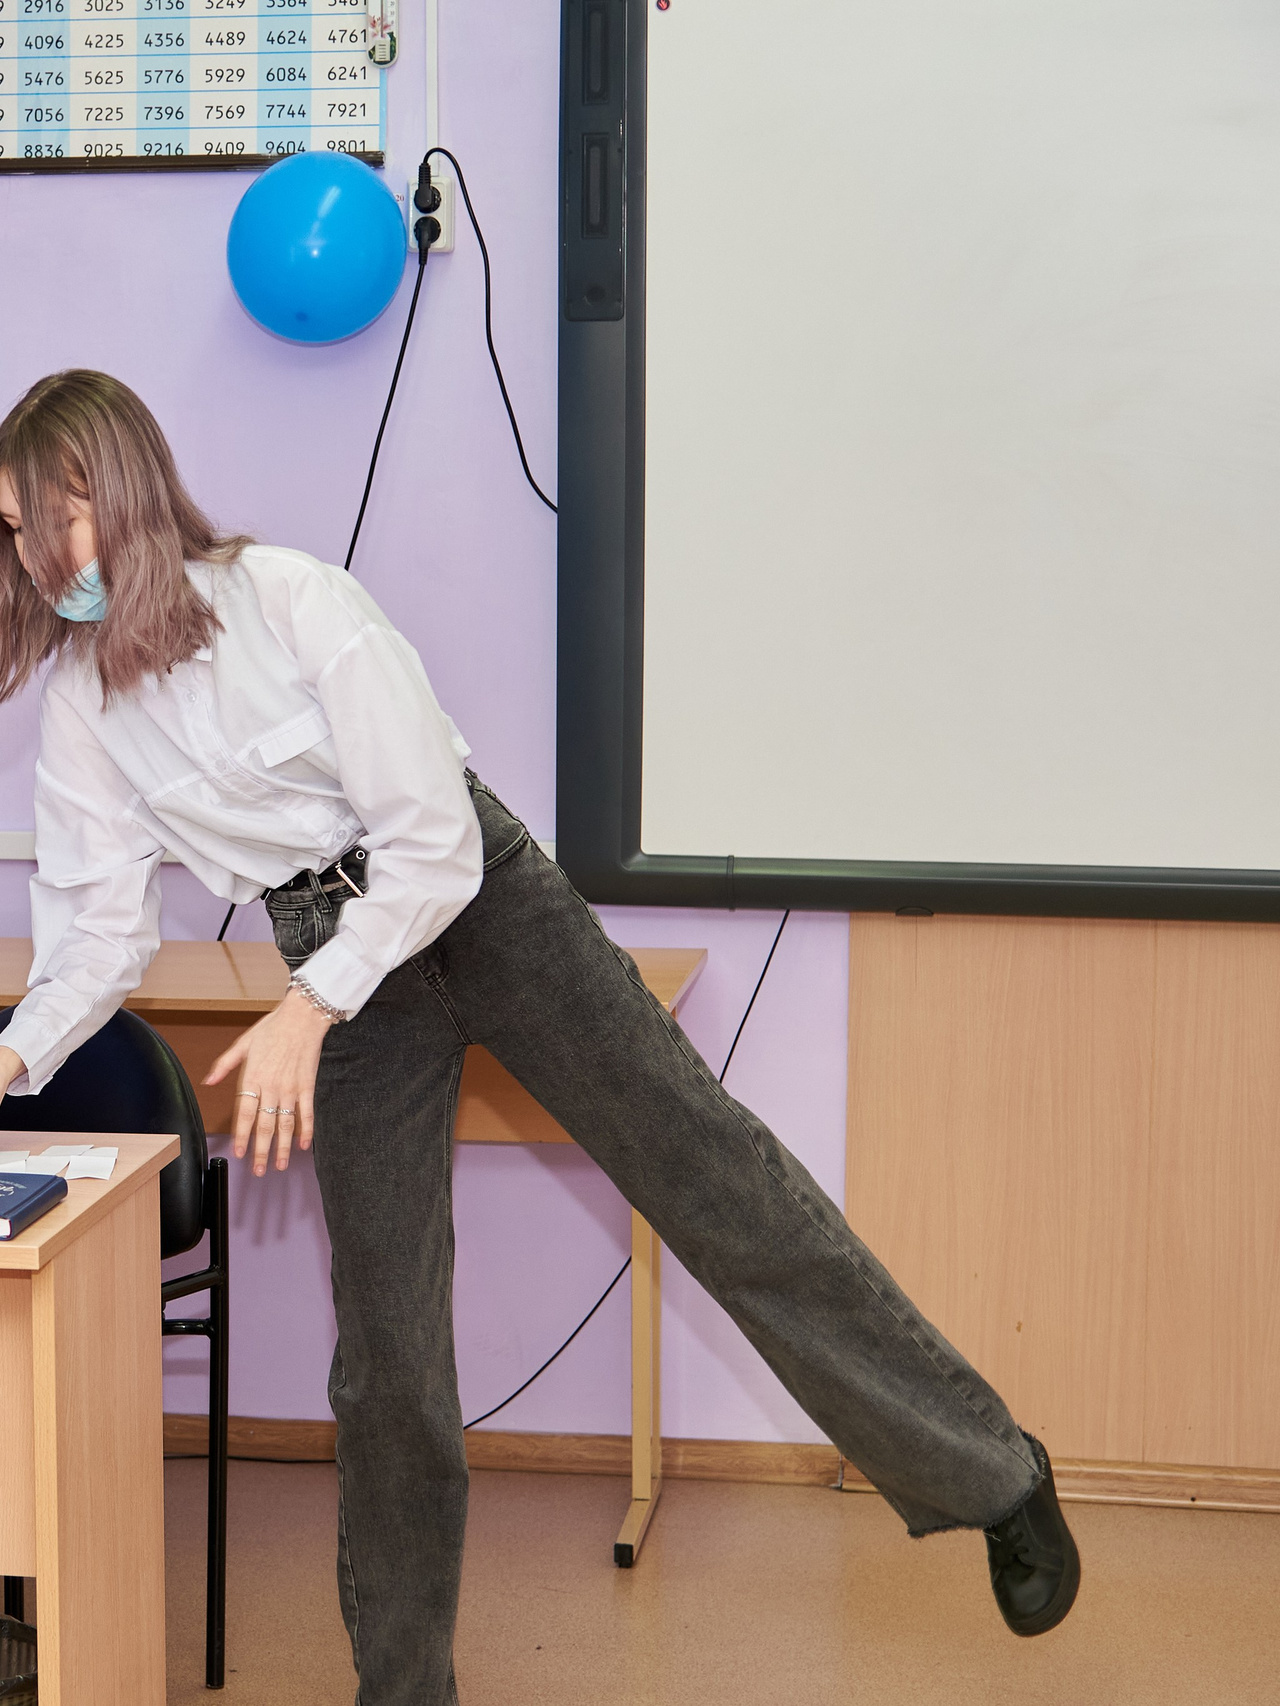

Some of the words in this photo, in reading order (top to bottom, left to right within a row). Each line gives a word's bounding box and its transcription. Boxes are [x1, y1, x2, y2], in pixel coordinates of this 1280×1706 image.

[25, 0, 63, 13] 2916
[85, 0, 123, 12] 3025
[145, 0, 184, 10] 3136
[25, 36, 64, 49] 4096
[85, 34, 123, 48] 4225
[145, 33, 184, 47] 4356
[206, 32, 245, 45] 4489
[267, 31, 306, 44] 4624
[328, 29, 366, 43] 4761
[25, 72, 63, 86] 5476
[85, 71, 123, 85] 5625
[145, 70, 184, 84] 5776
[206, 69, 245, 83] 5929
[266, 67, 306, 81] 6084
[328, 66, 366, 80] 6241
[25, 108, 64, 122] 7056
[85, 107, 123, 121] 7225
[145, 106, 184, 120] 7396
[205, 105, 245, 119] 7569
[266, 104, 306, 118] 7744
[328, 103, 365, 117] 7921
[24, 145, 63, 157] 8836
[83, 144, 123, 156] 9025
[143, 143, 183, 155] 9216
[204, 142, 244, 154] 9409
[266, 141, 306, 154] 9604
[327, 140, 367, 153] 9801
